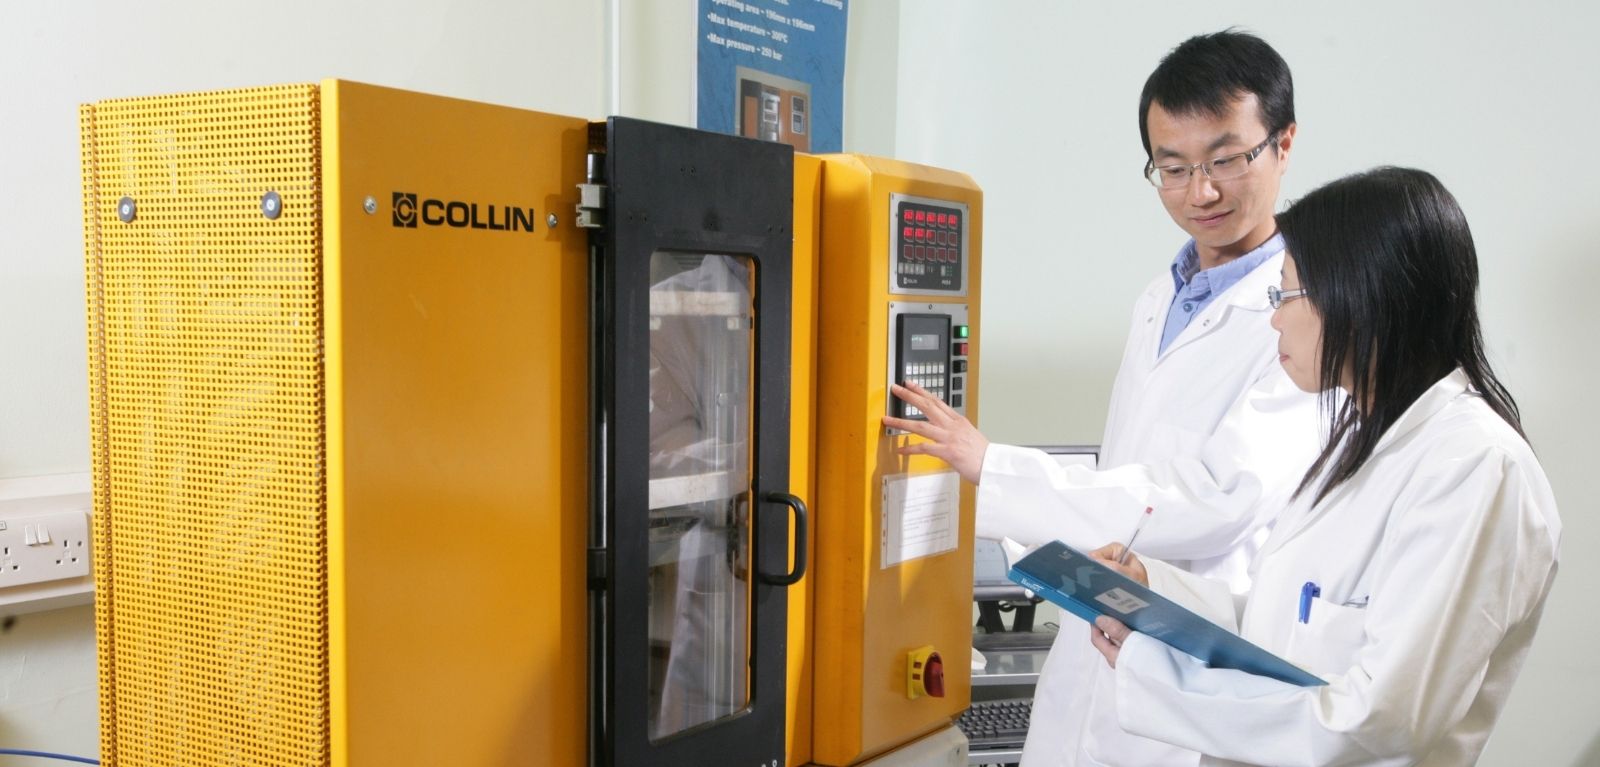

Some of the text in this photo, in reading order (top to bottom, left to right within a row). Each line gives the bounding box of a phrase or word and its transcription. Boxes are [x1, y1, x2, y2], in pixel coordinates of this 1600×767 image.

[745, 4, 760, 15] area
[726, 18, 766, 36] temperature
[726, 39, 755, 53] pressure
[773, 50, 783, 61] bar
[422, 199, 534, 232] COLLIN
